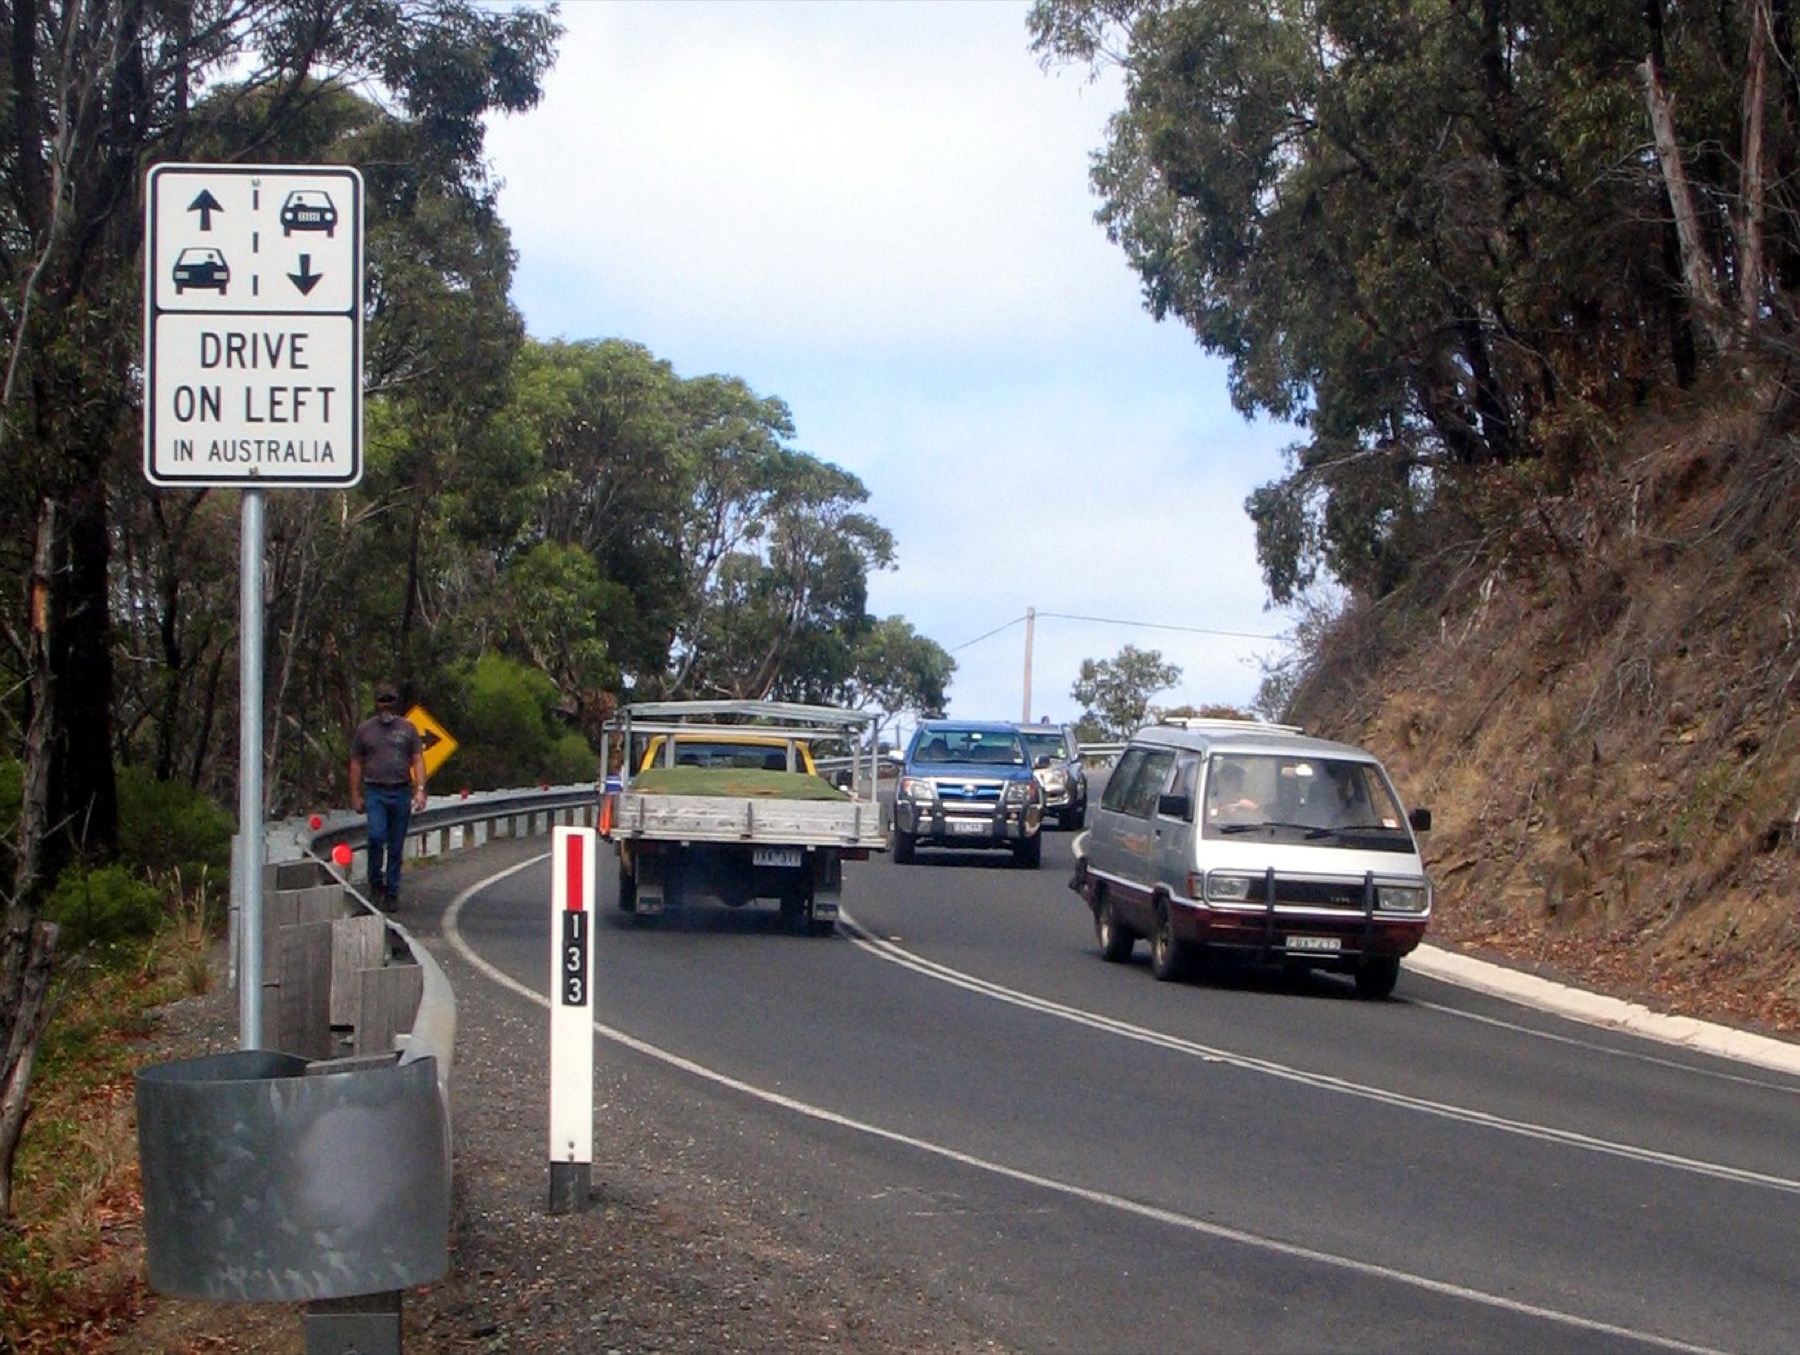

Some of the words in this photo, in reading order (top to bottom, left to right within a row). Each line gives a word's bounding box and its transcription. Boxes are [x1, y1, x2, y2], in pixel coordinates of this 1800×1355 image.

[200, 332, 309, 369] DRIVE
[173, 385, 222, 423] ON
[245, 386, 336, 423] LEFT
[173, 439, 193, 462] IN
[208, 439, 335, 463] AUSTRALIA
[567, 914, 582, 1002] 133
